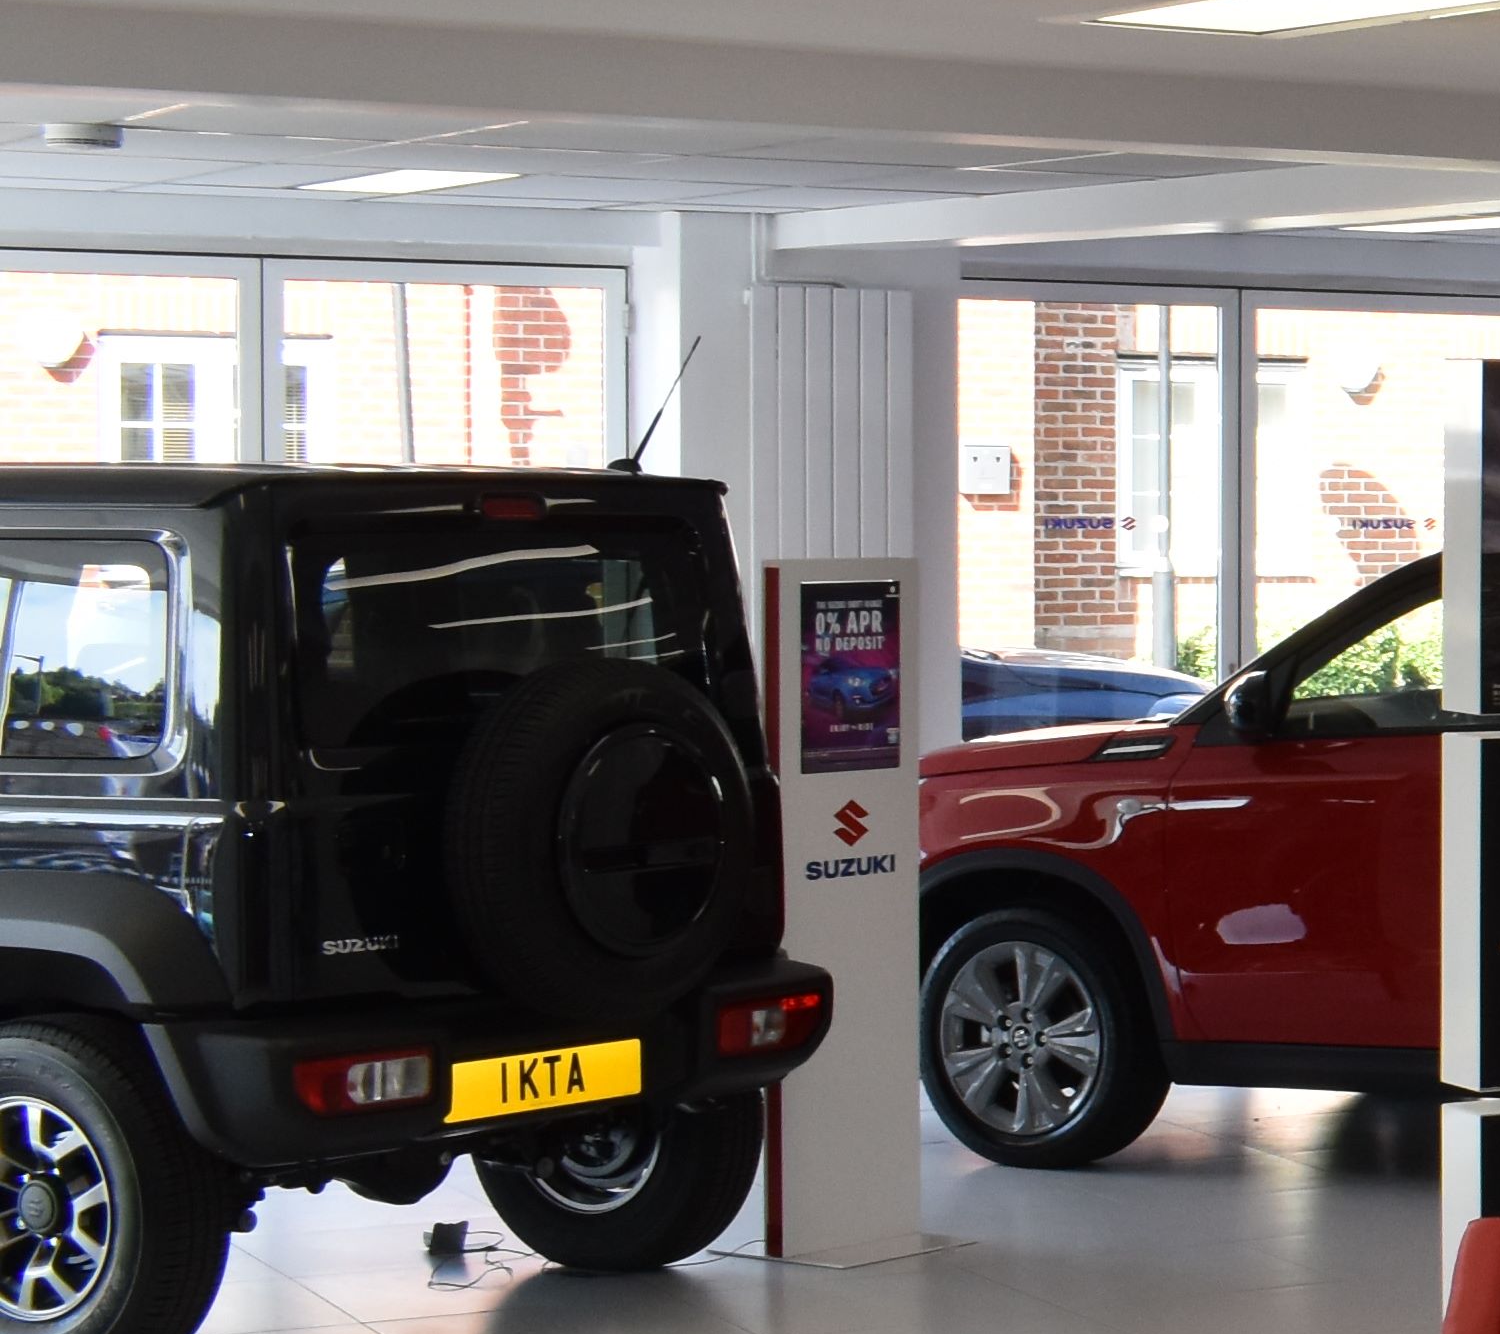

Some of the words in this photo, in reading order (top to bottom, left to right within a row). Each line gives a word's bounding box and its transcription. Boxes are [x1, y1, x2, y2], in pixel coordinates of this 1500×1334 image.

[815, 612, 841, 635] 0%
[846, 610, 883, 634] APR
[815, 637, 831, 652] NO
[835, 636, 884, 651] DEPOSIT
[805, 854, 896, 880] SUZUKI
[322, 934, 399, 956] SUZUKI
